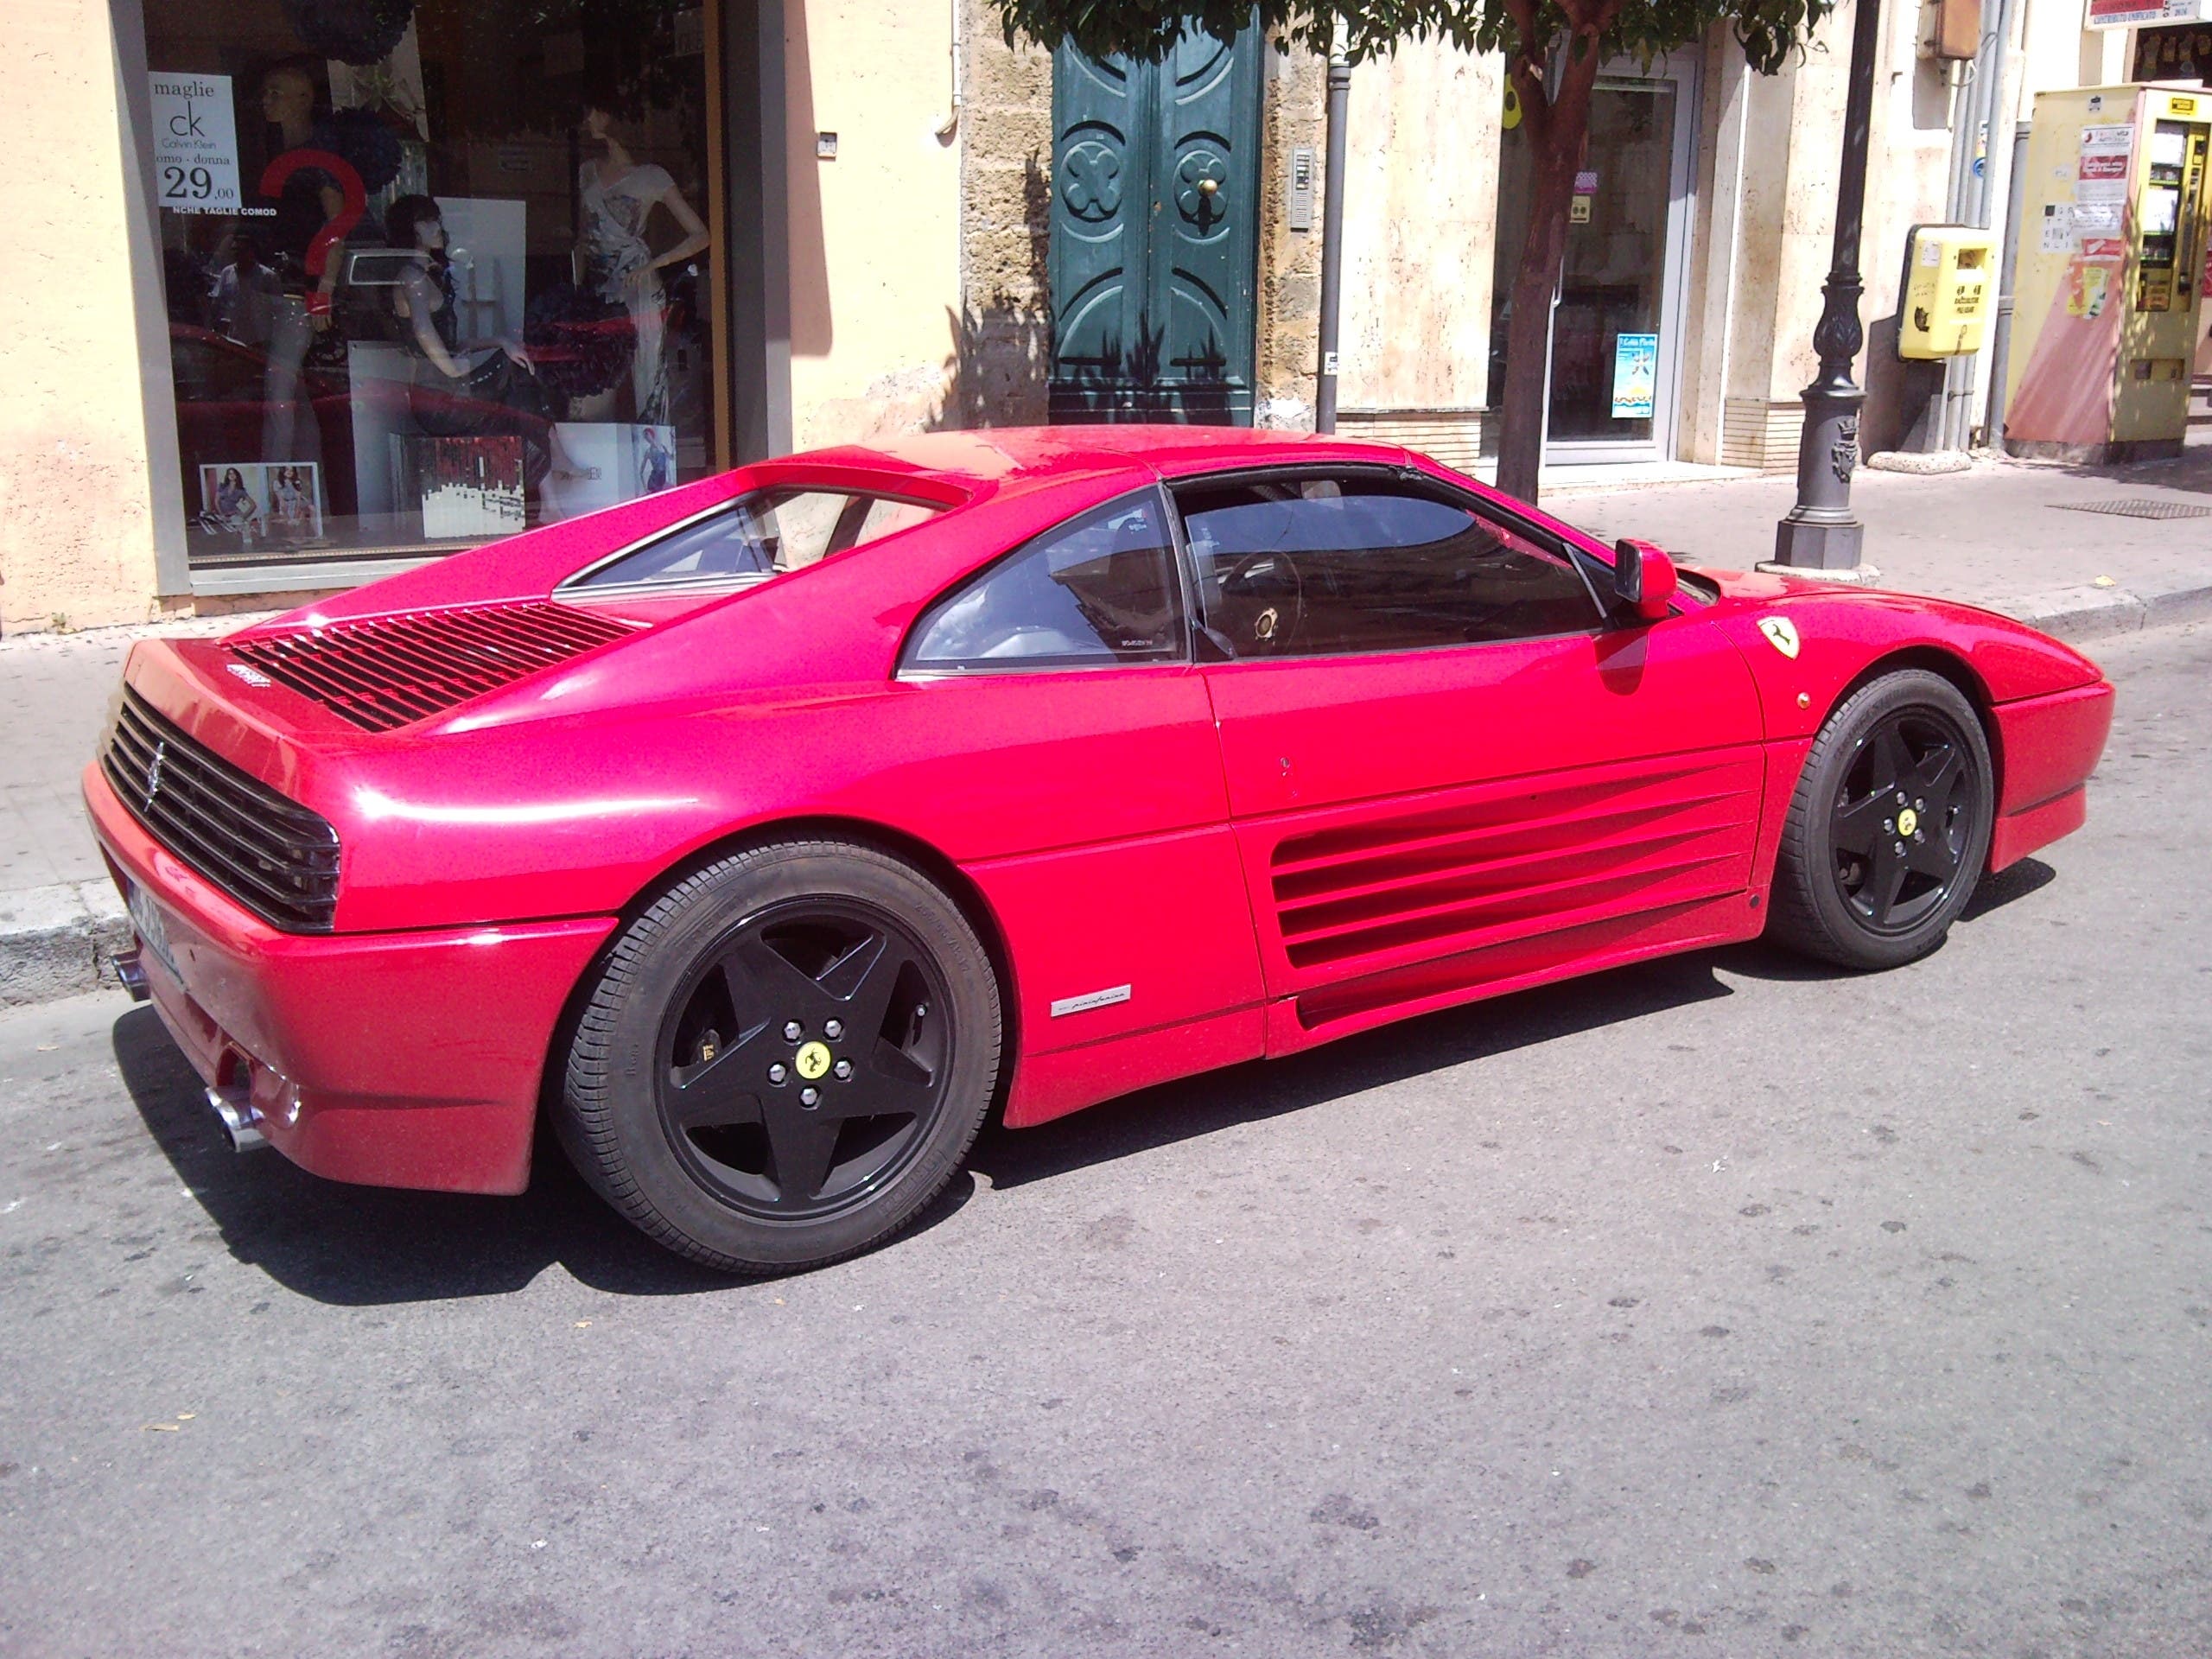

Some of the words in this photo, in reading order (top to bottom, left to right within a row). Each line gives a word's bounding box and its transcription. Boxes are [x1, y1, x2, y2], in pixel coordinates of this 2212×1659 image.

[154, 81, 214, 99] maglie
[169, 100, 206, 137] ck
[162, 138, 193, 149] Calvin
[193, 139, 217, 149] Klein
[194, 153, 230, 165] donna
[204, 207, 238, 215] TAGLIE
